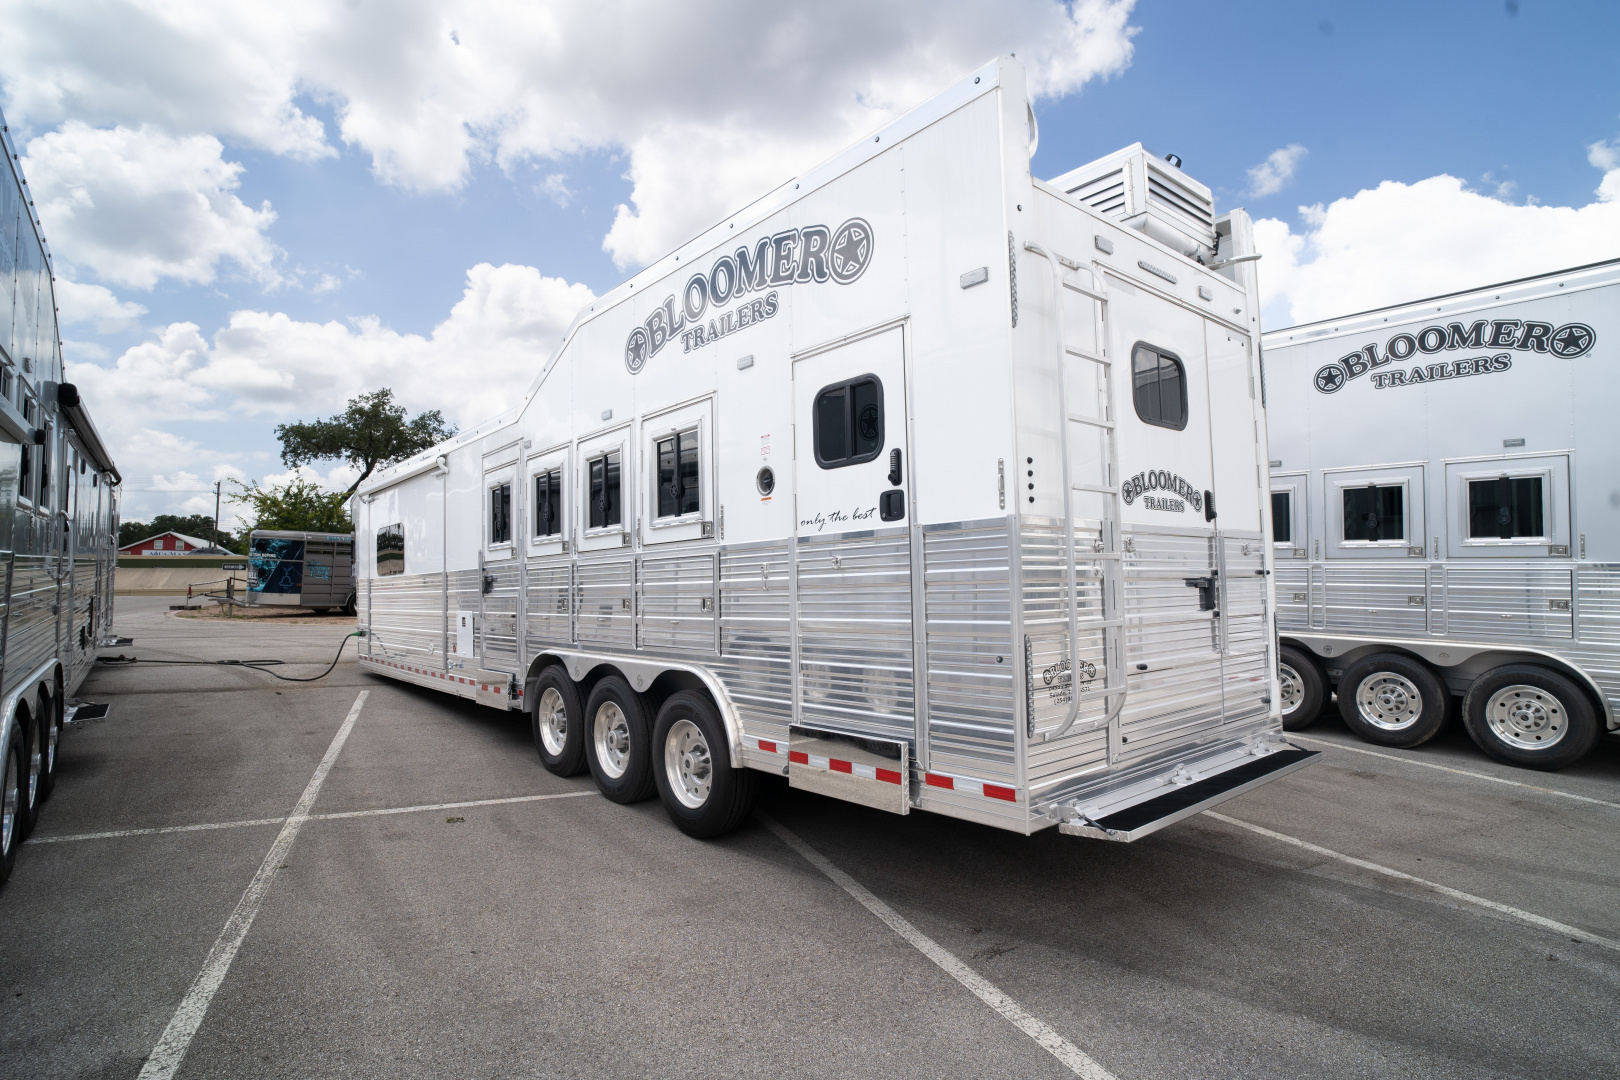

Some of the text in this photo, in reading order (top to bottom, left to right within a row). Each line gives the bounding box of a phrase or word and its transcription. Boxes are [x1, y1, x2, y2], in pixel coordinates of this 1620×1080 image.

[644, 223, 831, 358] BLOOMER
[681, 291, 780, 354] TRAILERS
[1338, 319, 1554, 381] BLOOMER
[1371, 353, 1512, 389] TRAILERS
[1131, 469, 1194, 507] BLOOMER
[1143, 496, 1185, 513] TRAILERS
[800, 507, 877, 531] only the best
[1049, 659, 1089, 678] BLOOER
